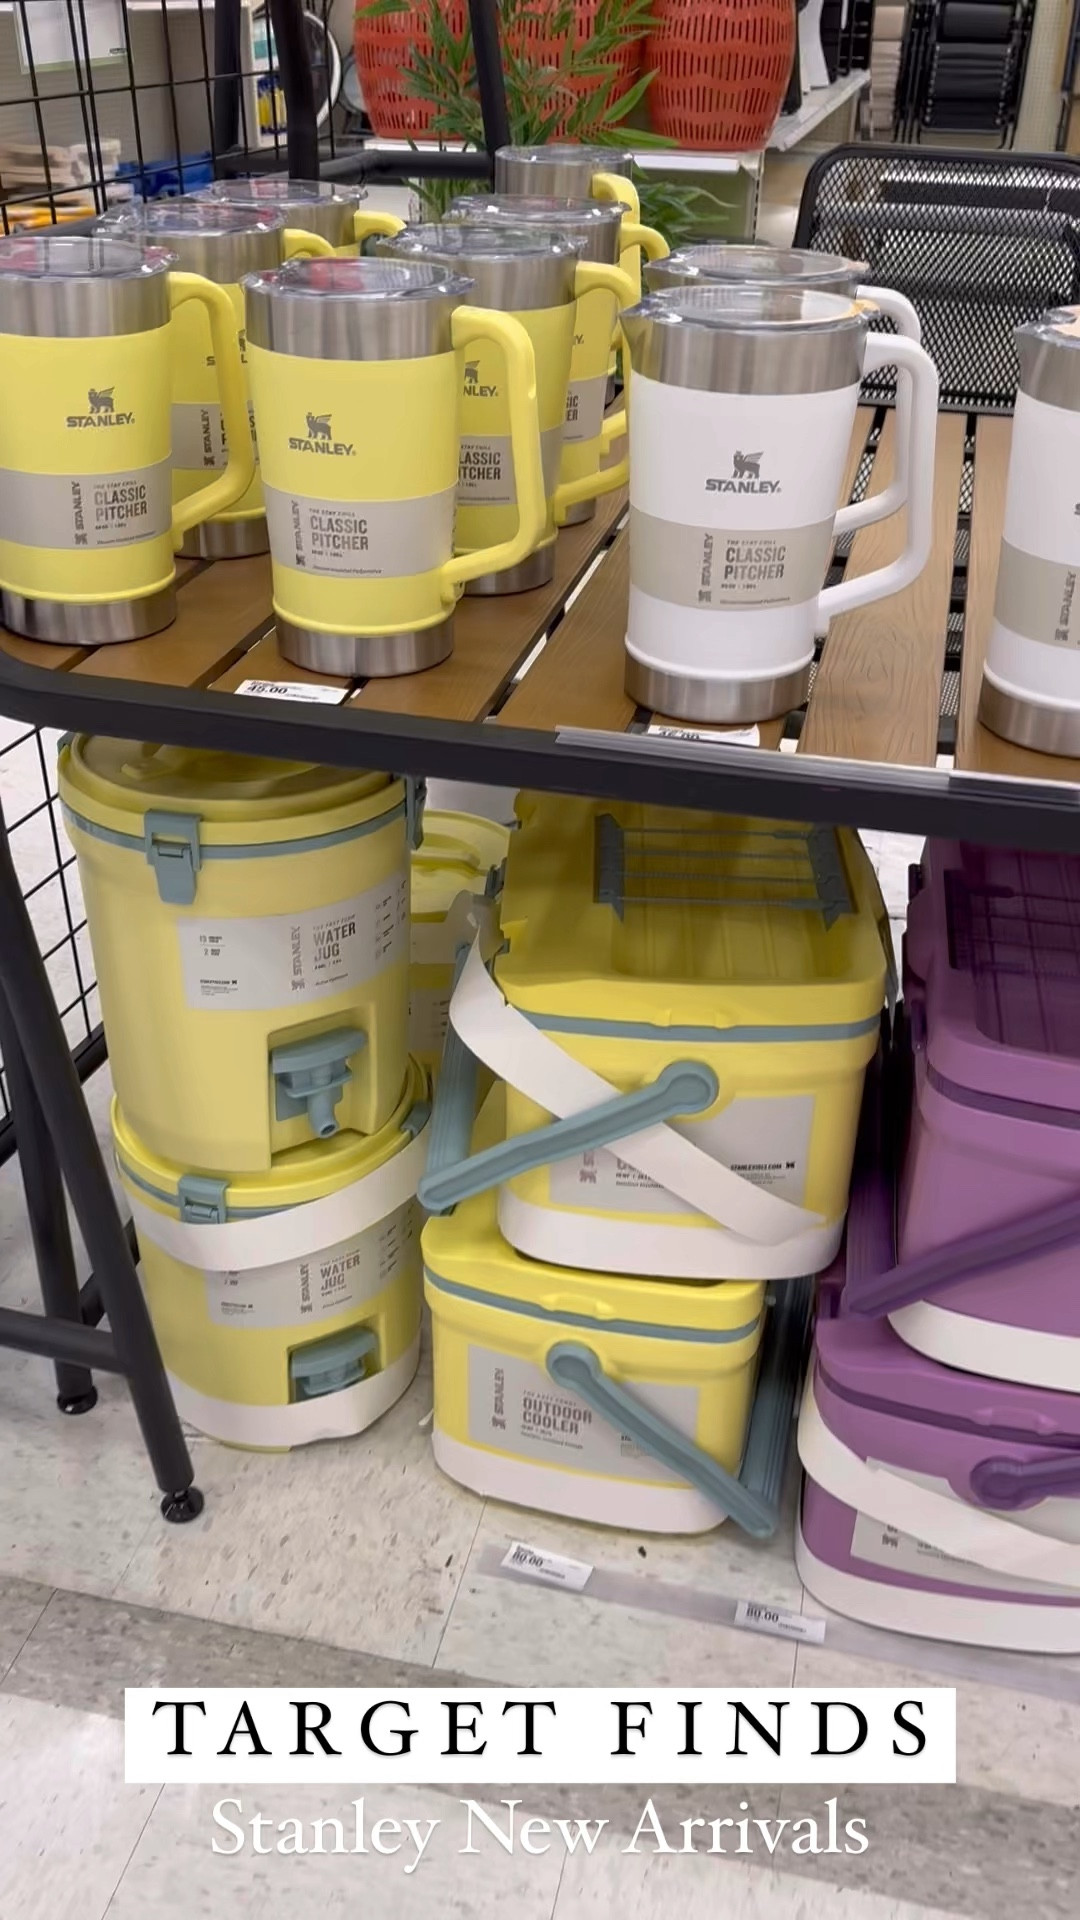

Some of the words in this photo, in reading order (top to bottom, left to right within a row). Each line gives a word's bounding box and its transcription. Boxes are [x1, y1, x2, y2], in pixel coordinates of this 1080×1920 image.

[463, 385, 497, 397] NLEY
[67, 412, 134, 428] STANLEY
[201, 408, 212, 453] STANLEY
[288, 437, 354, 456] STANLEY
[94, 485, 146, 505] CLASSIC
[705, 478, 781, 494] STANLEY
[72, 481, 84, 530] STANLEY
[96, 501, 147, 521] PITCHER
[310, 515, 367, 534] CLASSIC
[312, 532, 369, 551] PITCHER
[701, 533, 713, 587] STANLEY
[726, 546, 786, 564] CLASSIC
[724, 564, 785, 581] PITCHER
[247, 685, 288, 695] 45.00
[313, 922, 356, 946] WATER
[291, 926, 303, 976] STANLEY
[314, 943, 340, 962] JUG
[320, 1254, 360, 1279] WATER
[321, 1273, 345, 1291] JUG
[523, 1397, 592, 1425] OUTDOOR
[523, 1411, 579, 1435] COOLER
